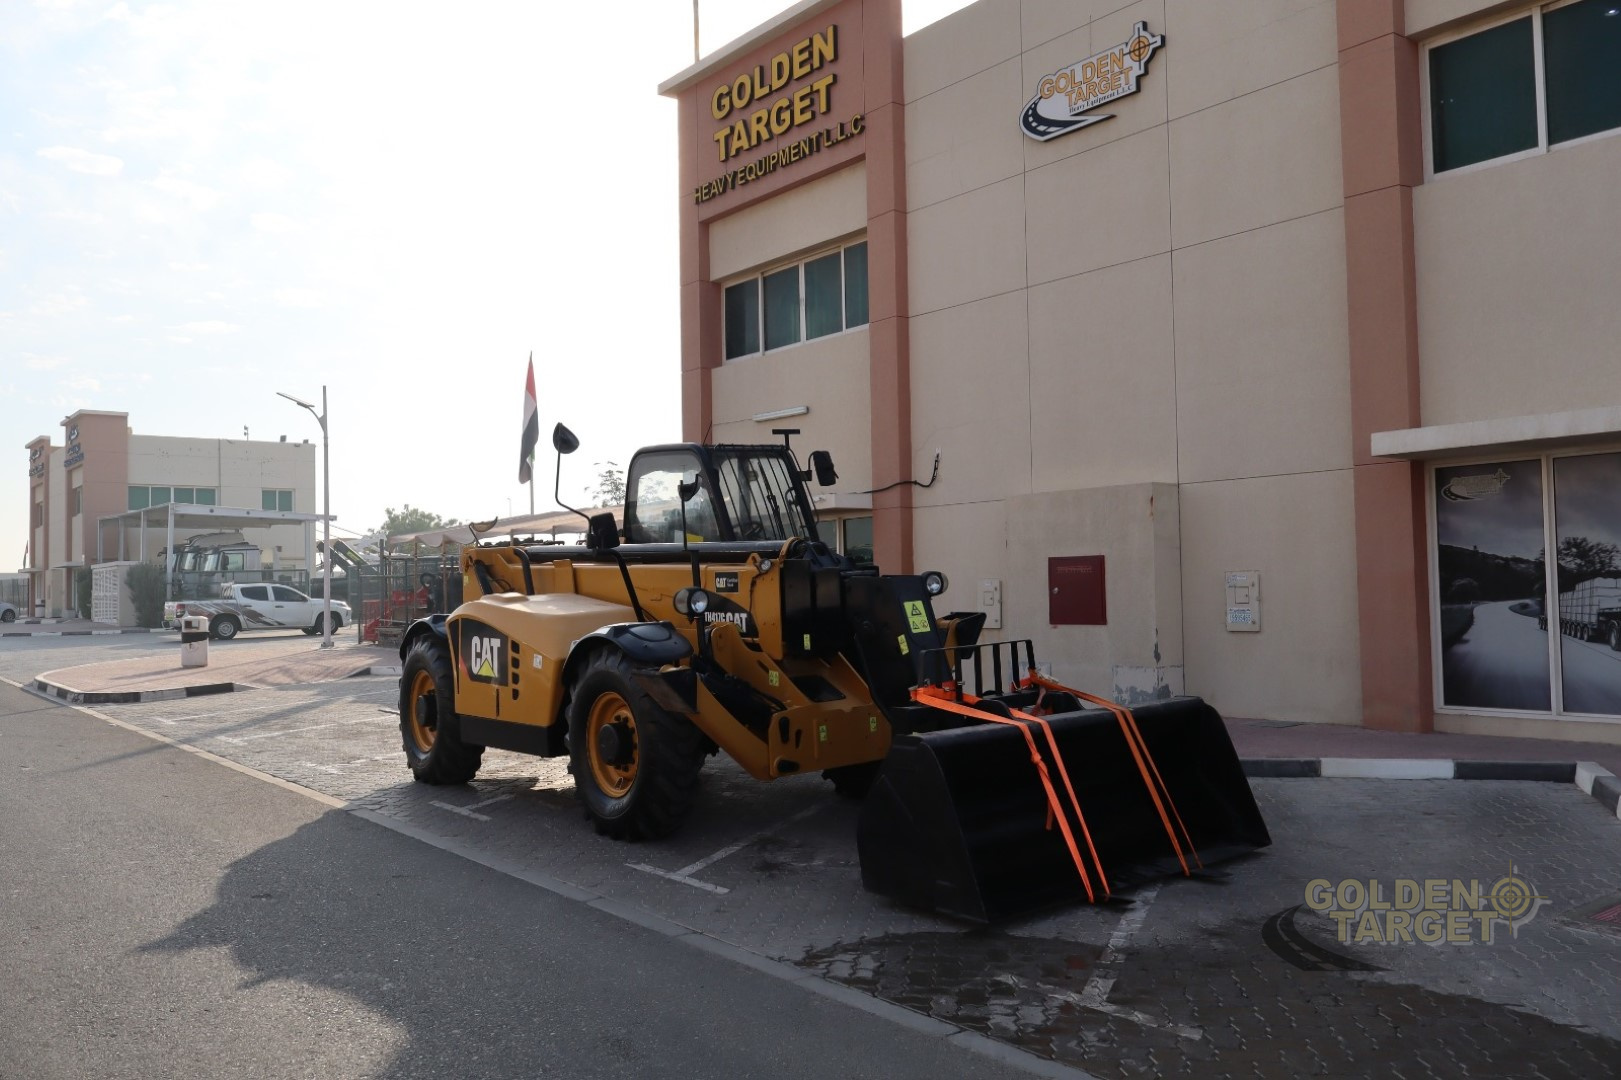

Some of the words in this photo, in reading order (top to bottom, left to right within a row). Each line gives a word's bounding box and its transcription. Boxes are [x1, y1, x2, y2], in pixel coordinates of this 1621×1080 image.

[711, 24, 836, 120] GOLDEN
[1040, 48, 1124, 99] GOLDEN
[1065, 66, 1133, 108] TARGET
[713, 73, 836, 163] TARGET
[1069, 104, 1085, 114] Heavy
[1086, 92, 1115, 107] Equipment
[694, 171, 736, 204] HEAVY
[737, 131, 821, 185] EQUIPMENT
[716, 577, 727, 588] CAT
[471, 636, 501, 678] CAT
